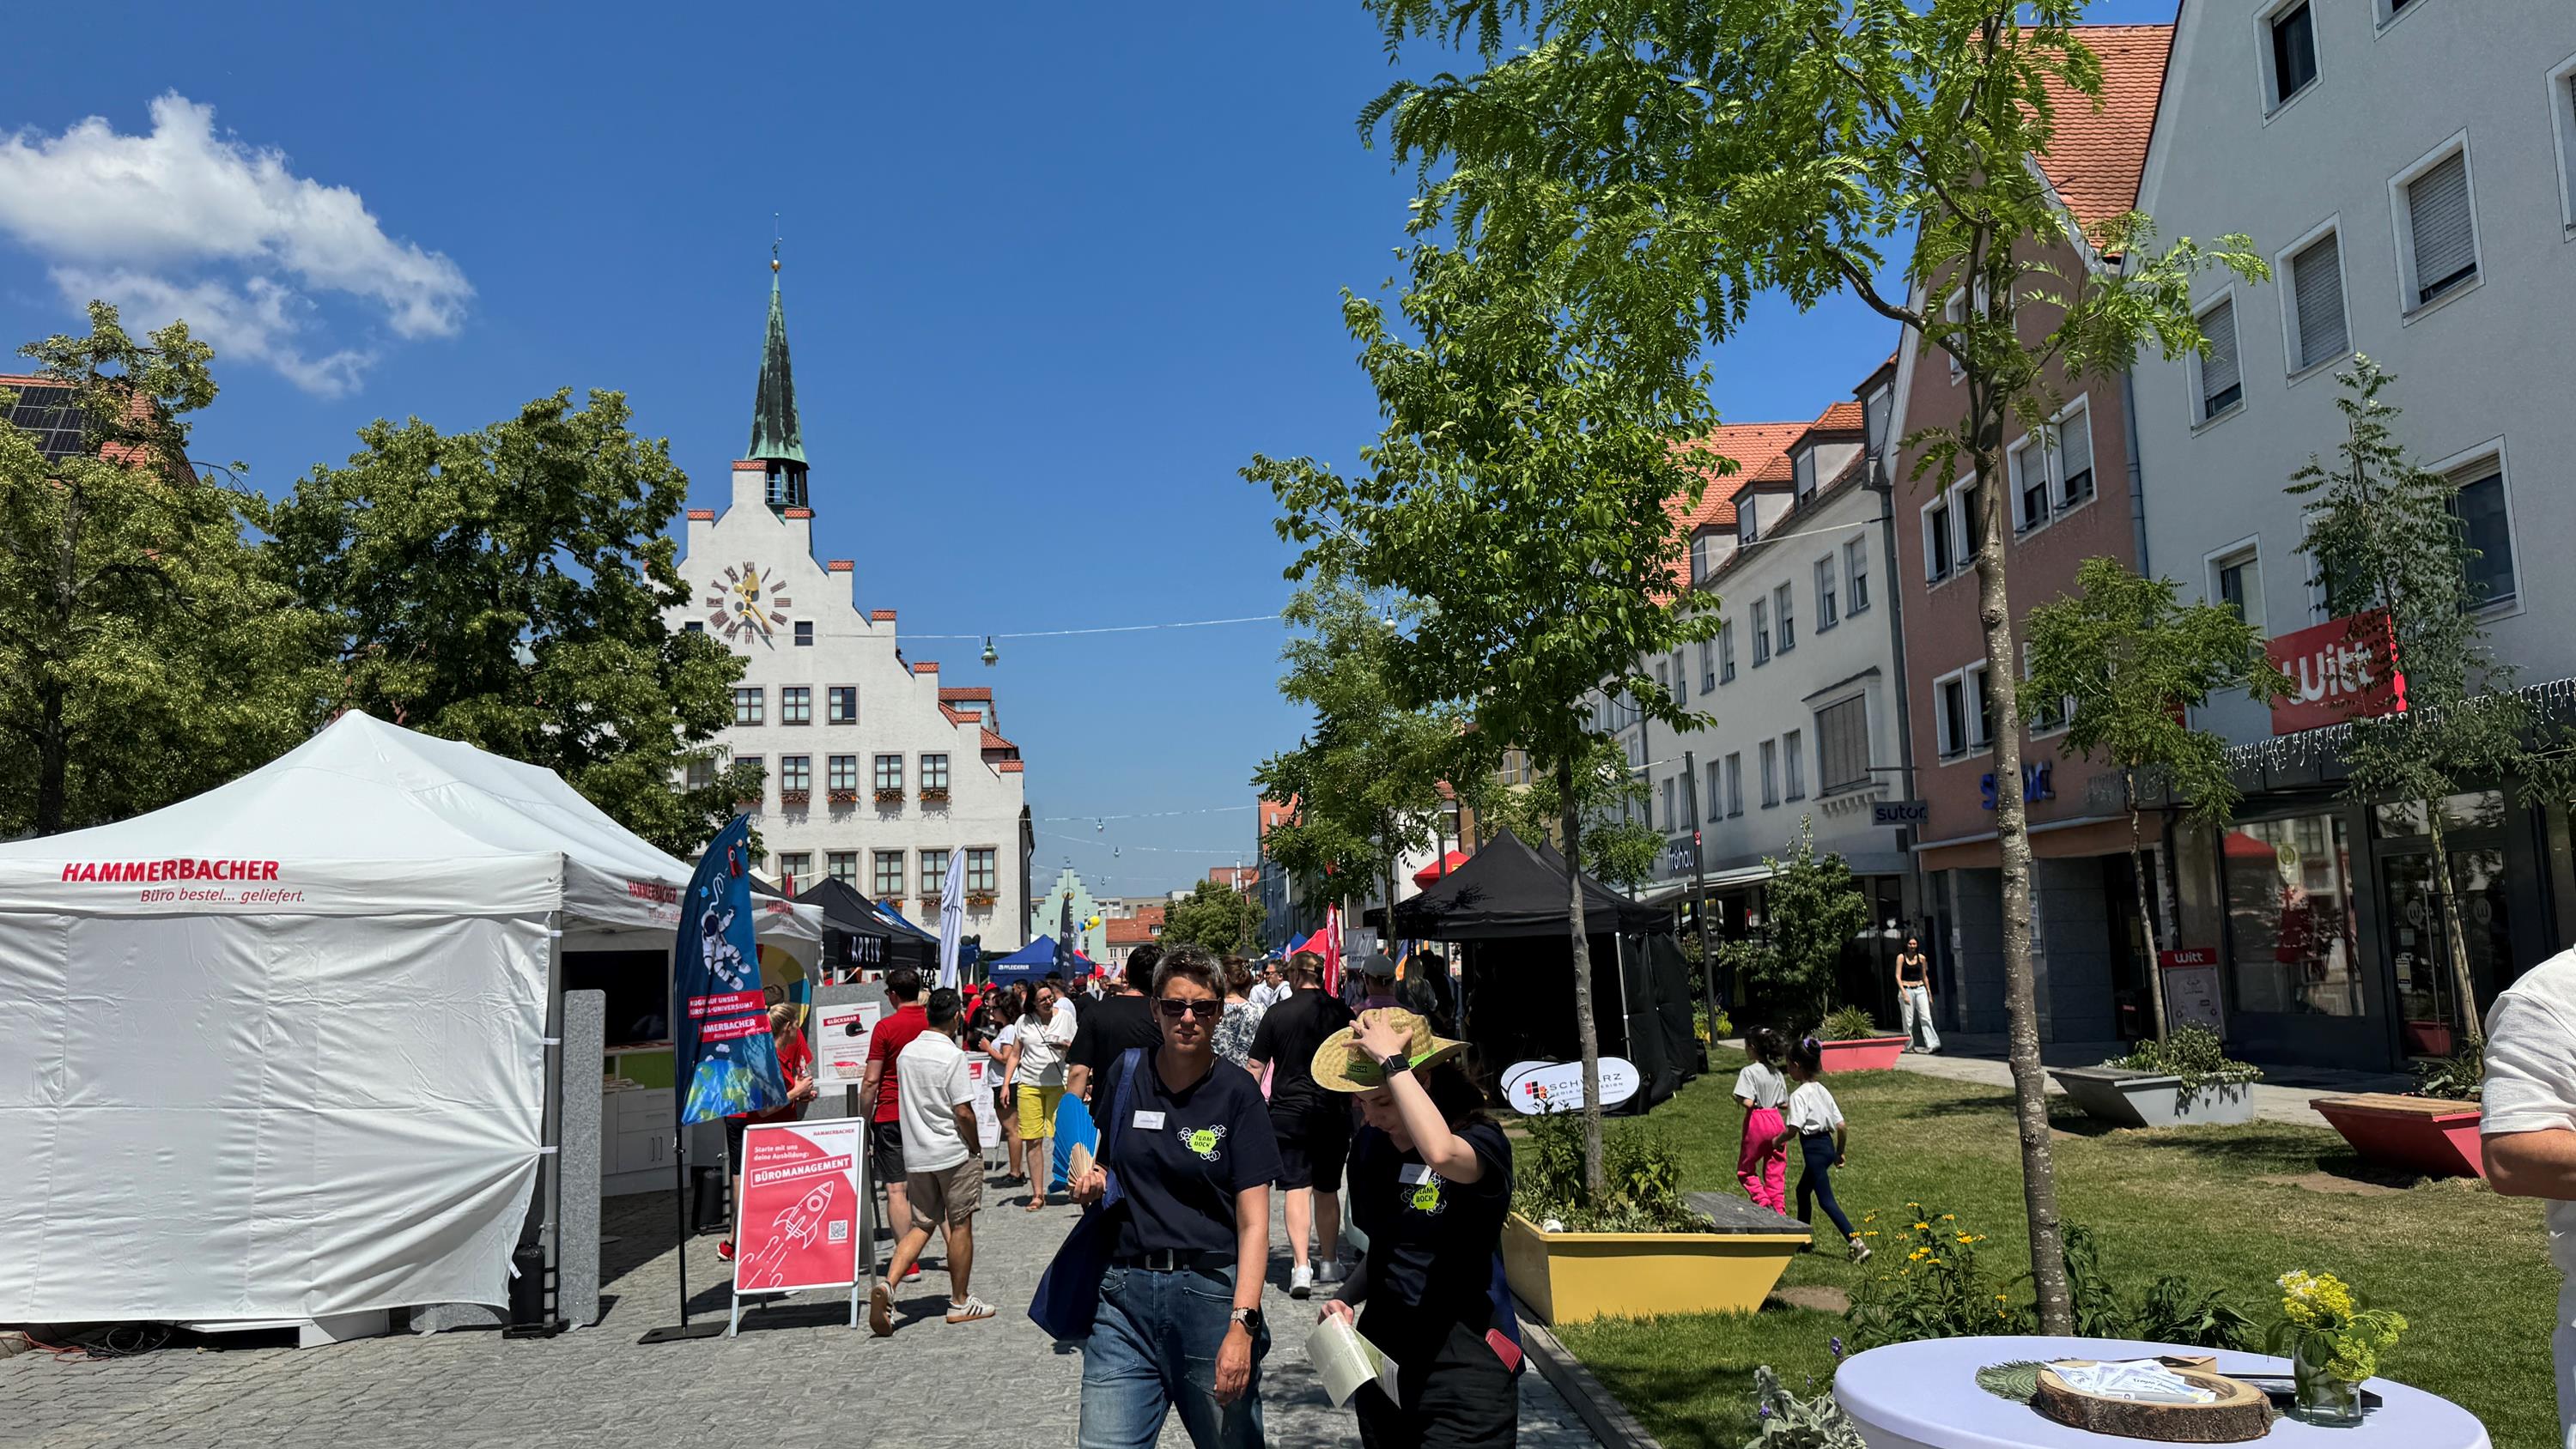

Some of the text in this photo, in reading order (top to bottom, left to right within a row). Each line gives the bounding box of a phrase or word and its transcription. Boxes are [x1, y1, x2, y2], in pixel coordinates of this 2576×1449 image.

[1668, 845, 1694, 871] frühau
[62, 859, 279, 882] HAMMERBACHER
[140, 888, 306, 905] Büro bestel... geliefert.
[1549, 1073, 1622, 1091] SCHRZ
[813, 1128, 855, 1137] HAMMERBACHER
[754, 1158, 850, 1182] BÜROMANAGEMENT
